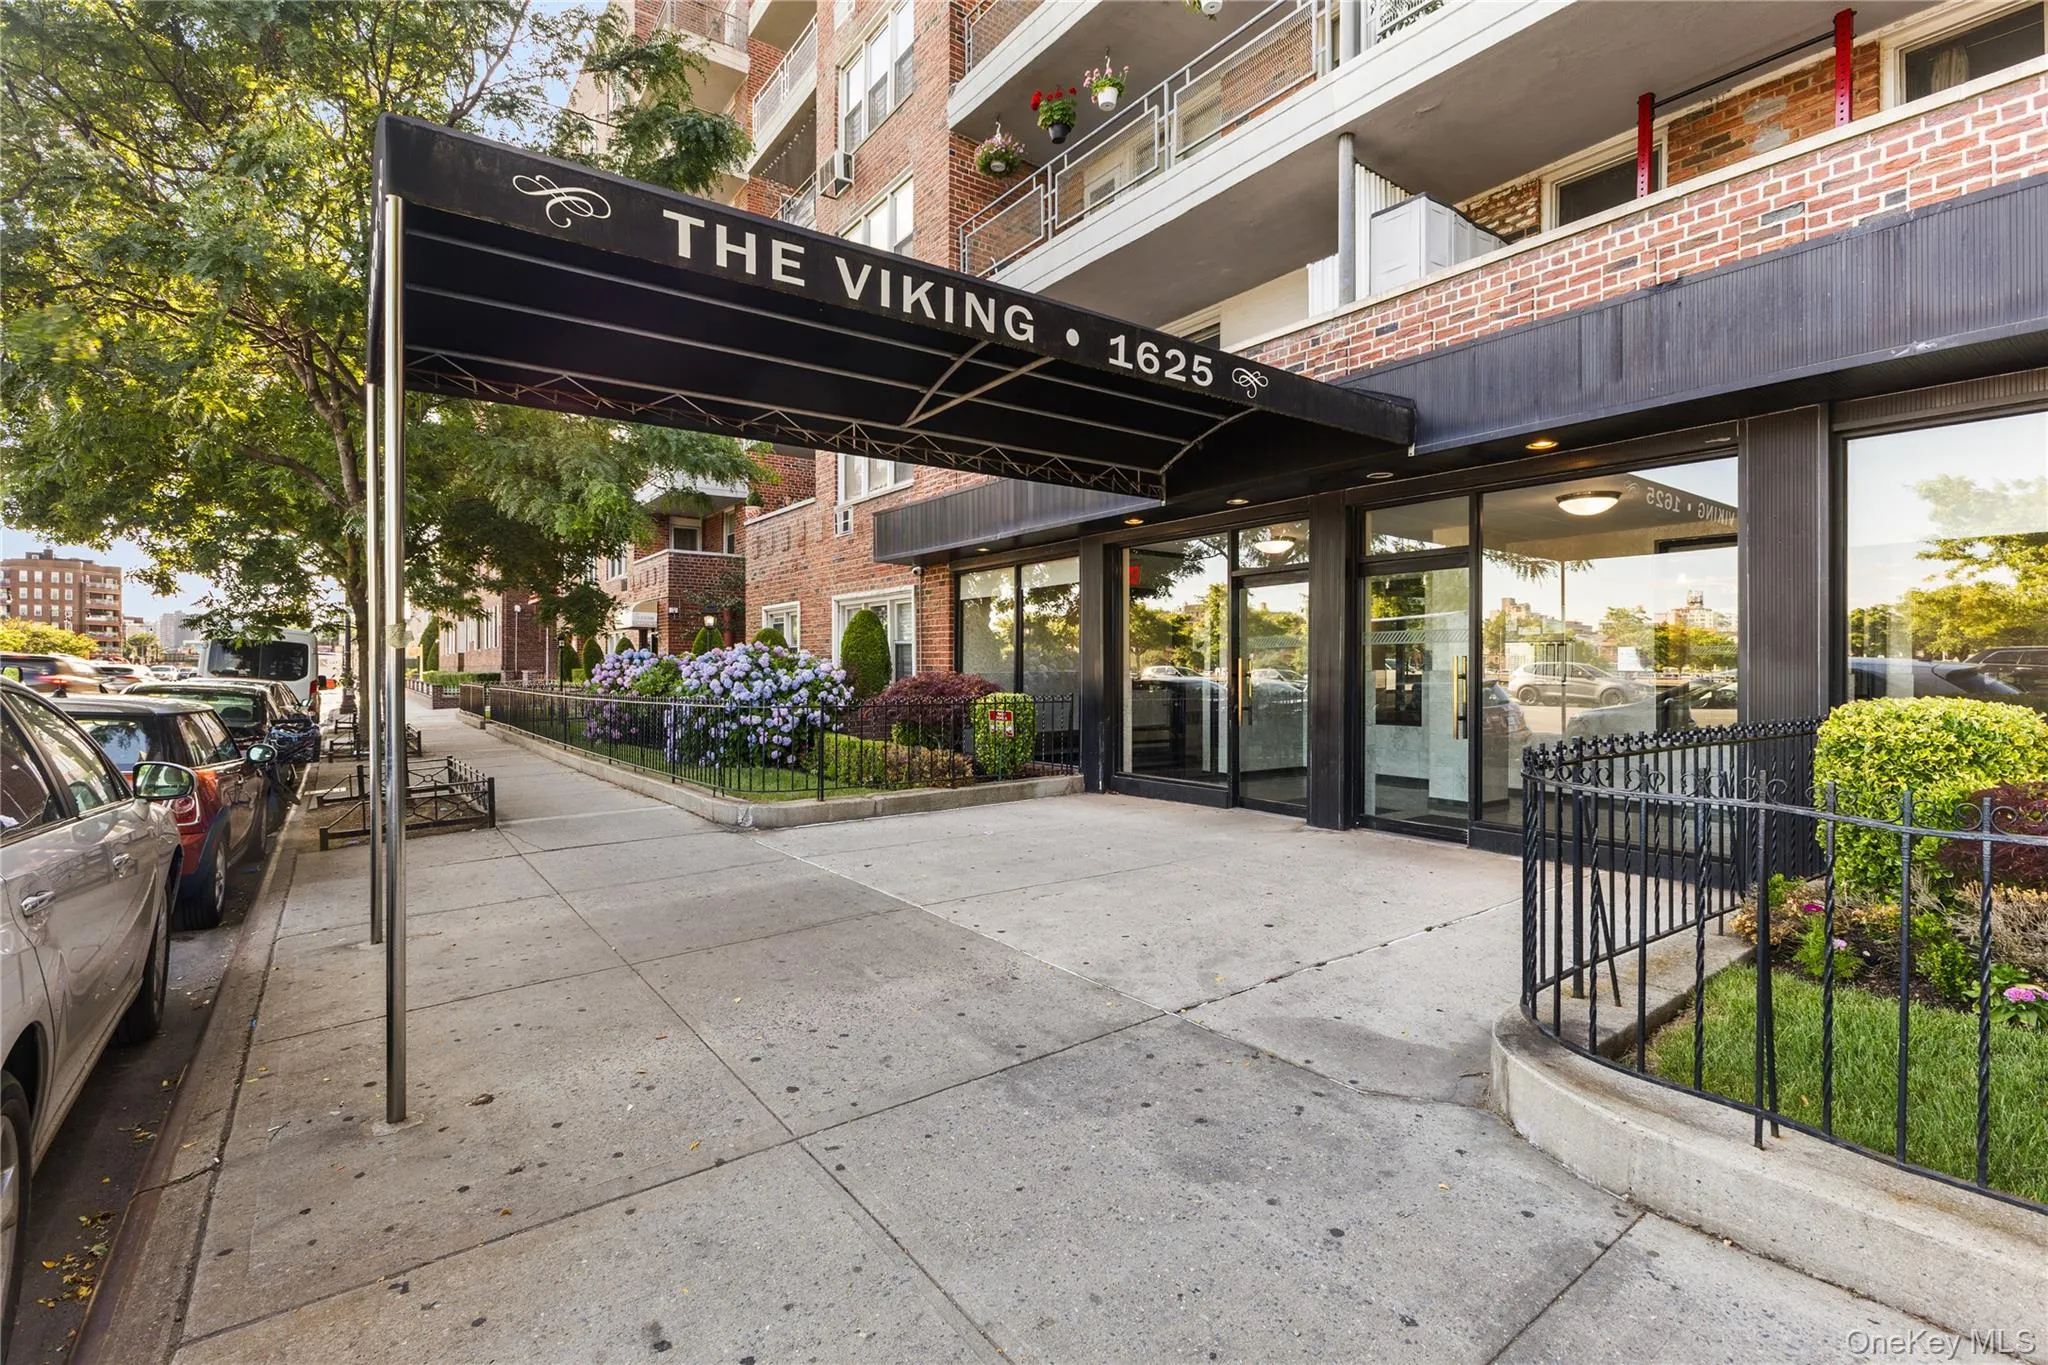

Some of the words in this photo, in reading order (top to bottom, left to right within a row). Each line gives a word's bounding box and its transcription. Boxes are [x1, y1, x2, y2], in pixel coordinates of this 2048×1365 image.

[662, 209, 805, 287] THE
[835, 256, 1035, 345] VIKING
[1109, 334, 1214, 388] 1625
